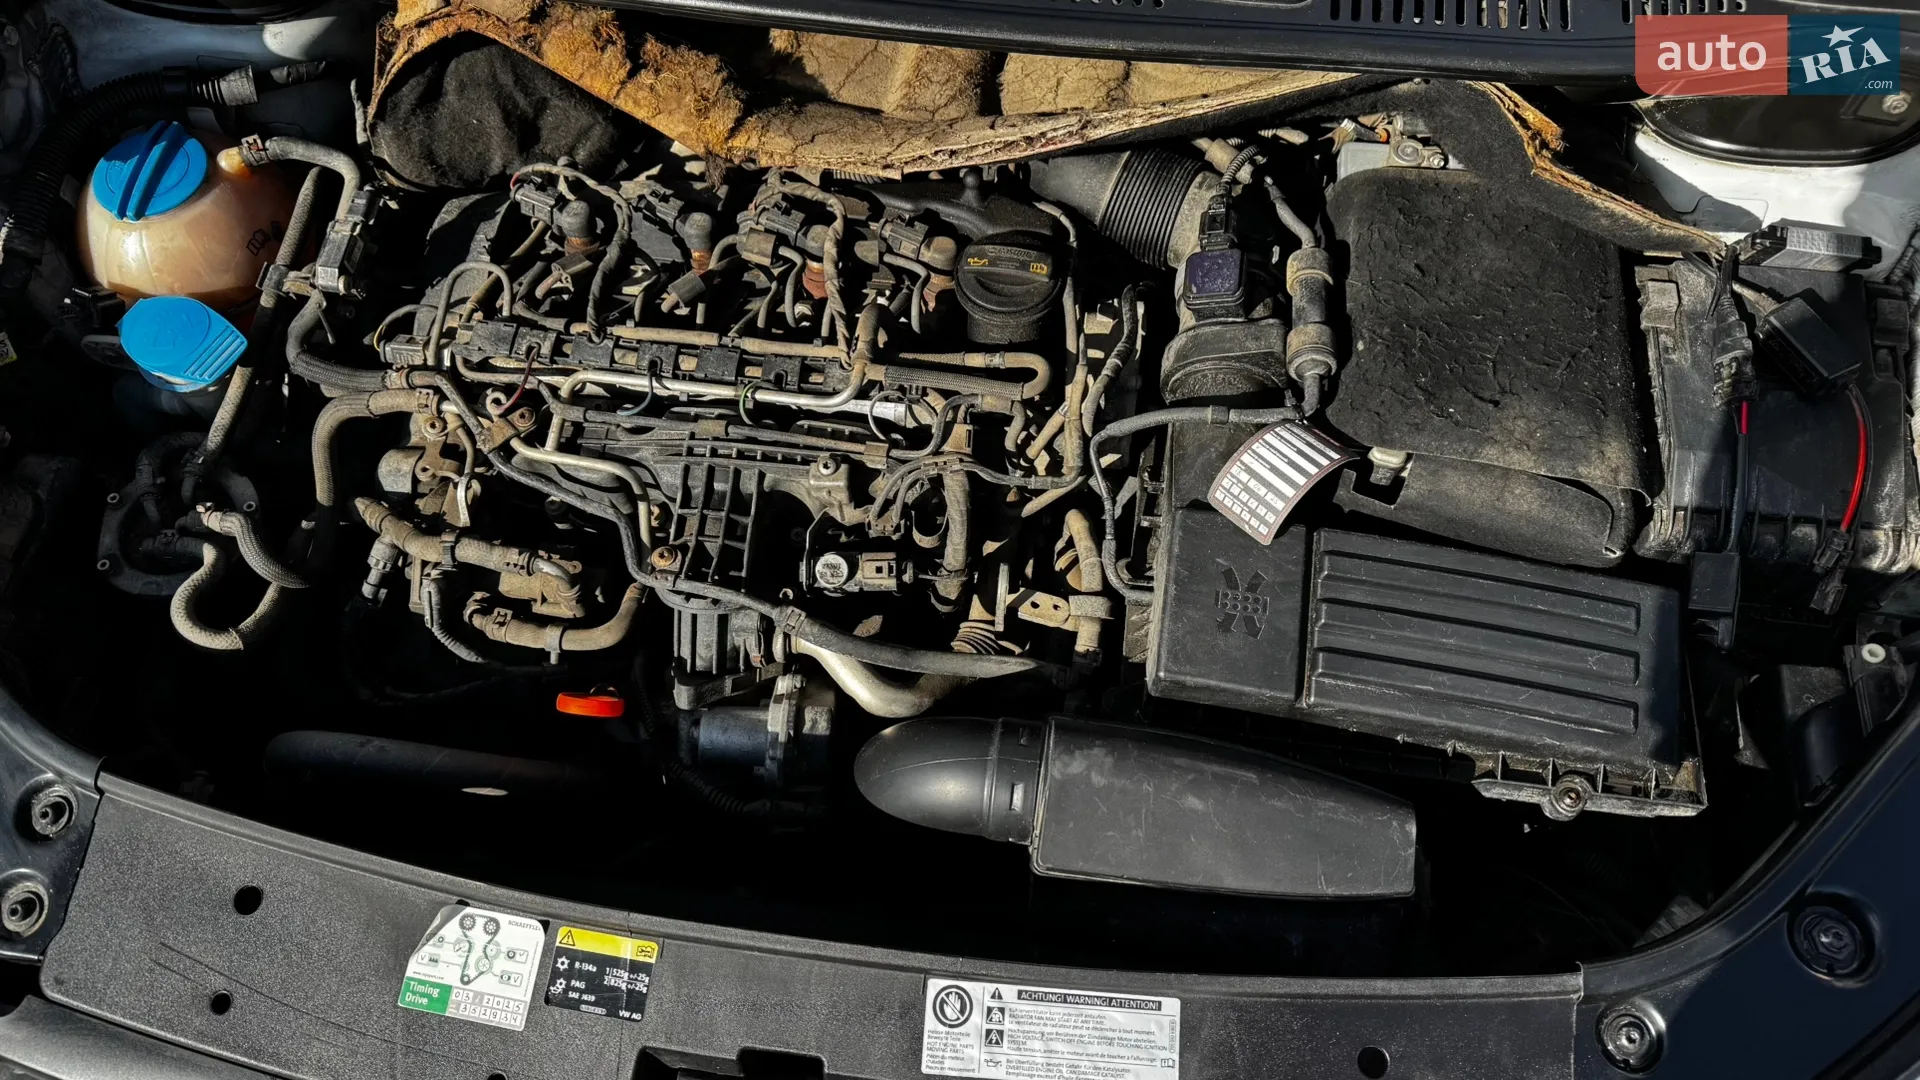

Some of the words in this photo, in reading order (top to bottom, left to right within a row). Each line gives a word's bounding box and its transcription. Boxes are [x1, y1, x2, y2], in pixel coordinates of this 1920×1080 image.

[574, 961, 597, 972] R-134a
[613, 968, 629, 980] 525g
[409, 982, 440, 997] Timing
[571, 980, 586, 989] PAG
[405, 992, 428, 1005] Drive
[568, 991, 580, 999] SAE
[1021, 992, 1064, 1002] ACHTUNG!
[1066, 995, 1109, 1006] WARNING!
[1111, 999, 1159, 1010] ATTENTION!
[485, 997, 522, 1012] 2025
[619, 1010, 631, 1018] VW
